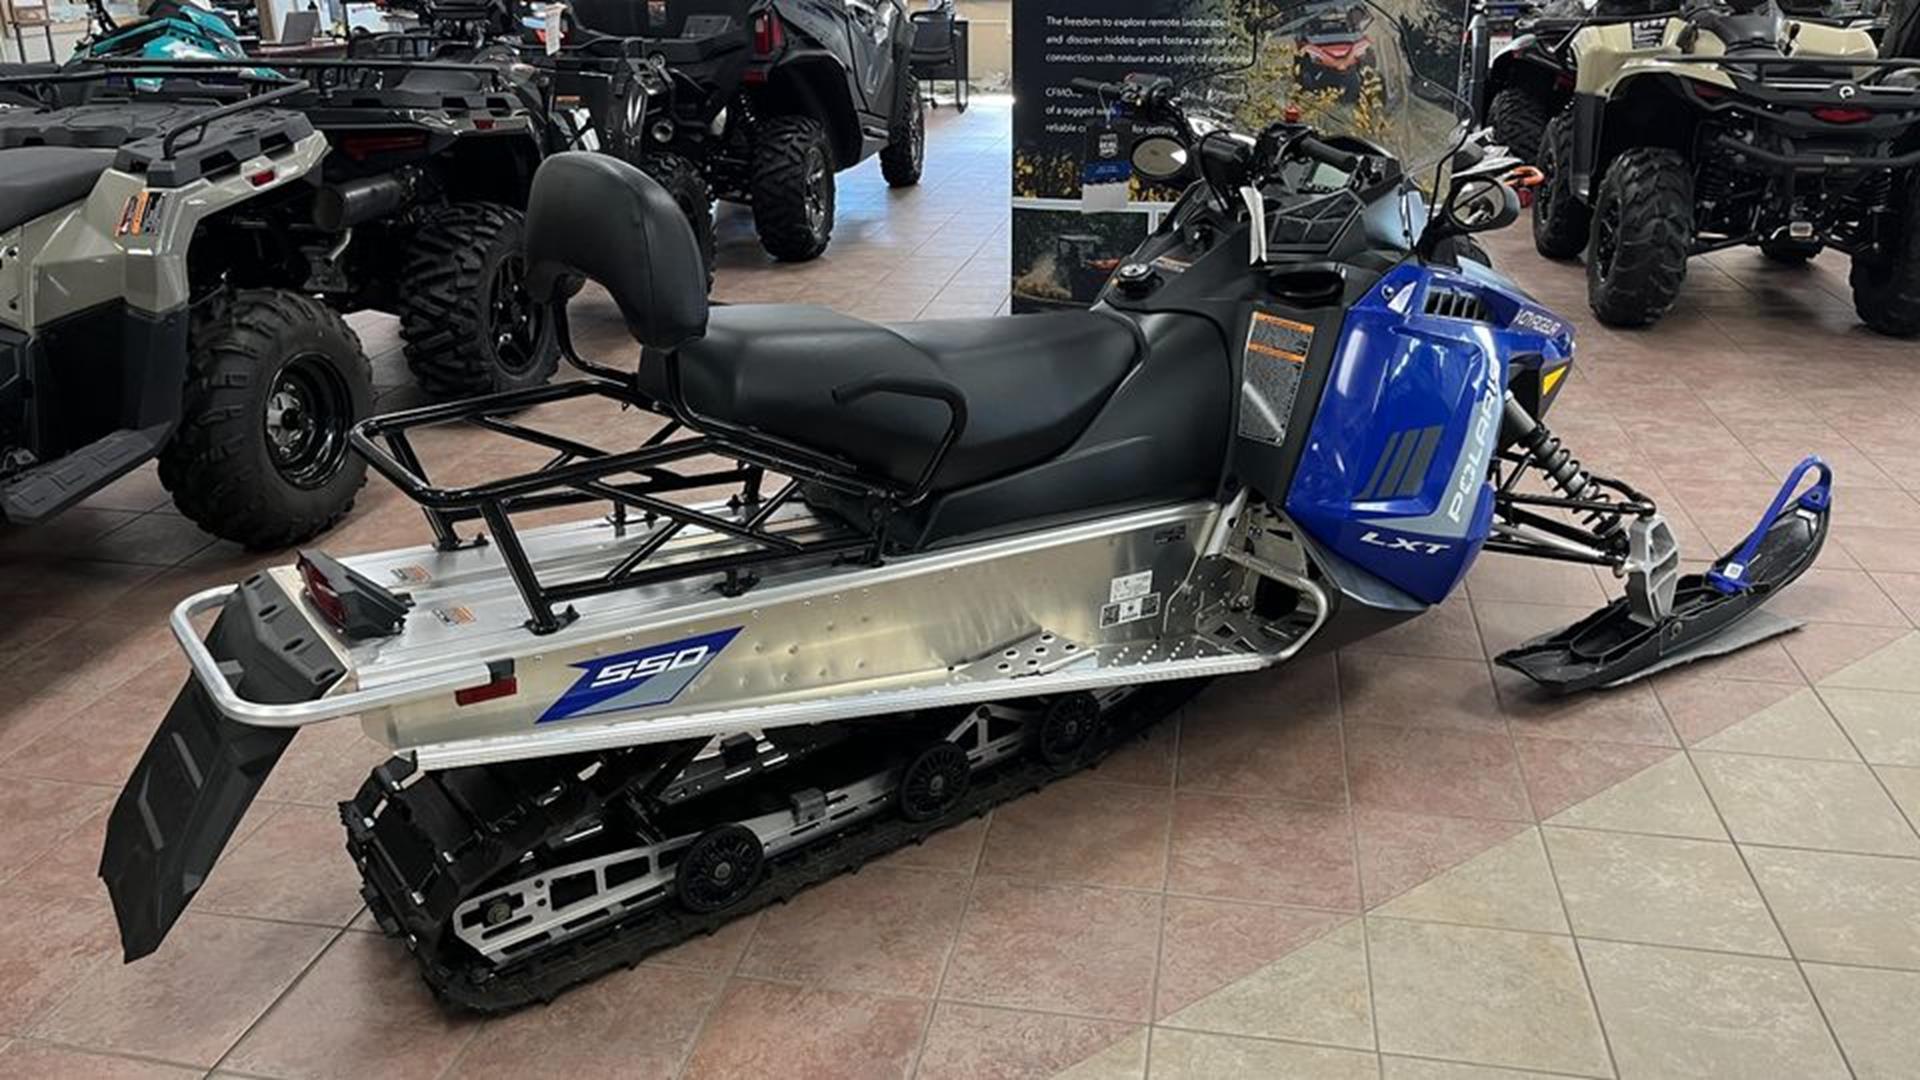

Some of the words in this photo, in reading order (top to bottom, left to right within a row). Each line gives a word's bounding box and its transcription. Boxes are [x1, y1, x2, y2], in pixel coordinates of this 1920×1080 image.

[1046, 15, 1062, 26] The
[1064, 15, 1101, 27] freedom
[1102, 17, 1113, 27] to
[1114, 17, 1145, 29] explore
[1147, 18, 1180, 27] remote
[1045, 34, 1063, 45] and
[1065, 34, 1102, 45] discover
[1104, 35, 1135, 45] hidden
[1137, 37, 1161, 48] gems
[1163, 35, 1193, 46] fosters
[1045, 53, 1094, 63] connection
[1096, 53, 1116, 63] with
[1118, 54, 1146, 64] nature
[1147, 53, 1165, 64] and
[1166, 55, 1172, 64] a
[1045, 105, 1056, 115] of
[1056, 107, 1062, 115] a
[1063, 106, 1095, 118] rugged
[1045, 123, 1077, 133] reliable
[1131, 124, 1145, 134] for
[1360, 531, 1451, 555] LXT
[590, 645, 709, 688] 550
